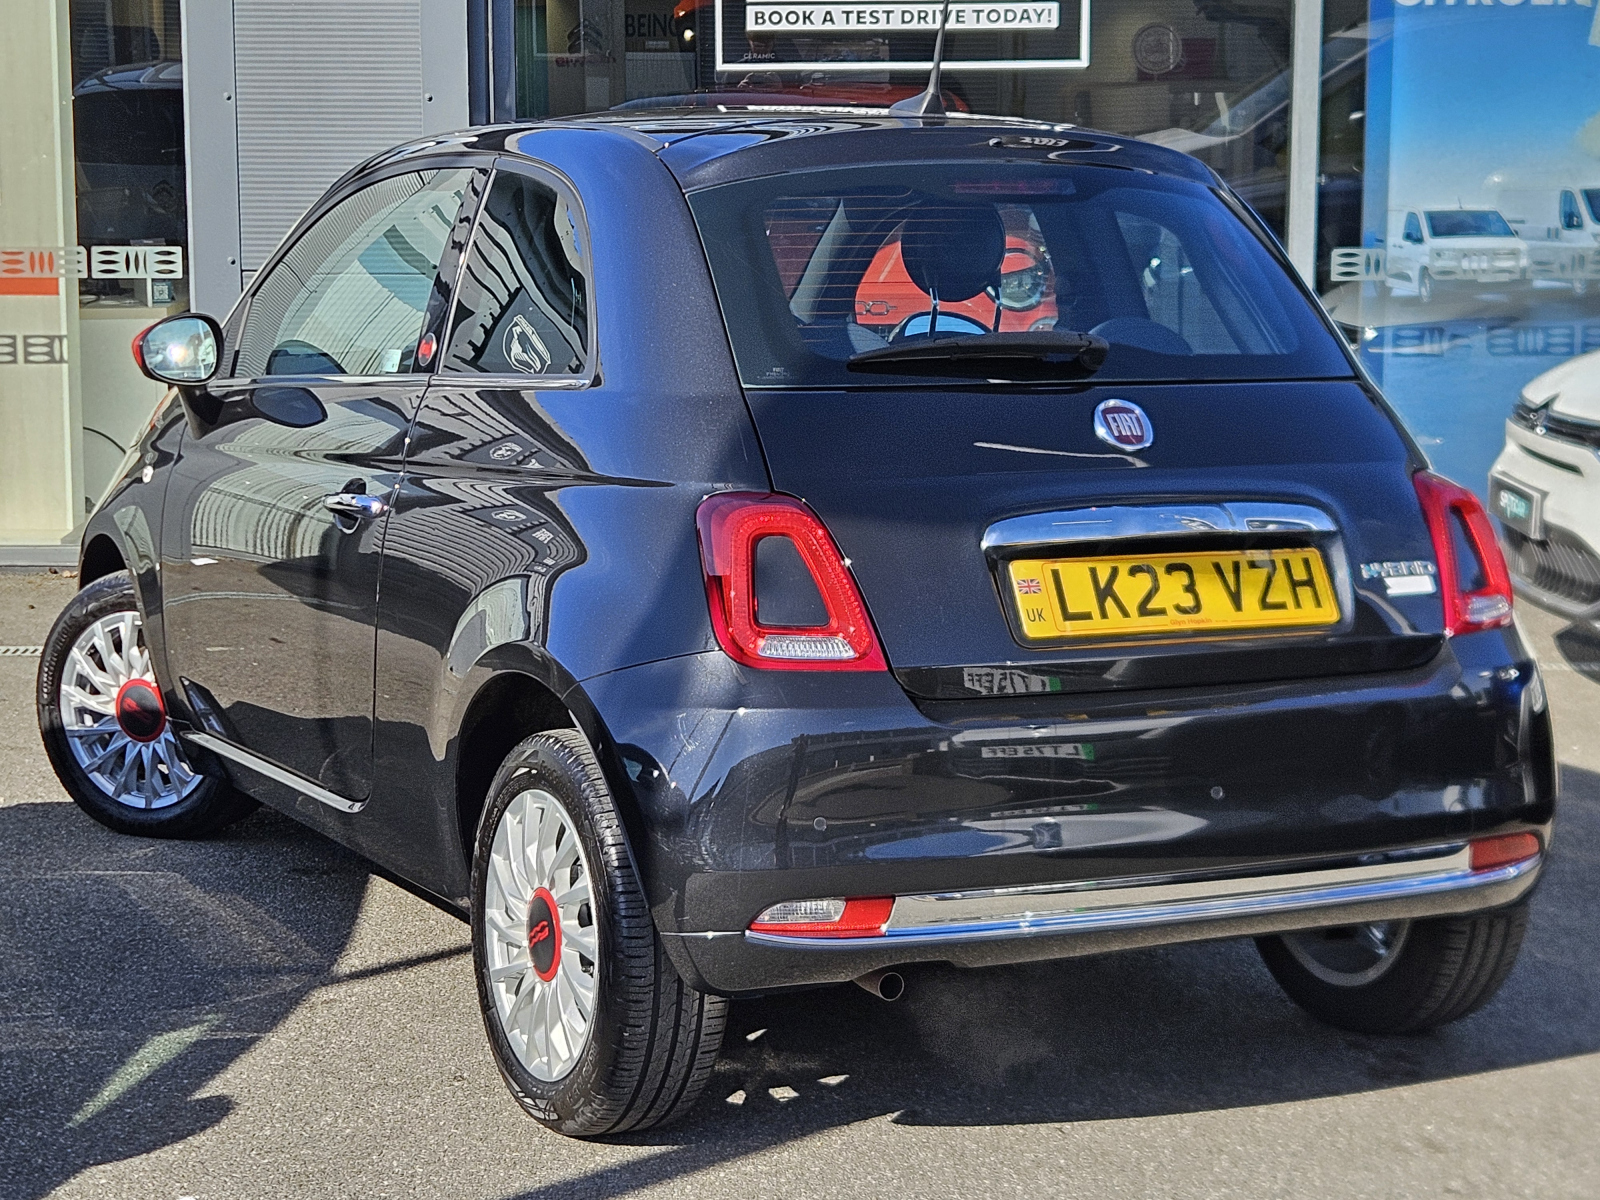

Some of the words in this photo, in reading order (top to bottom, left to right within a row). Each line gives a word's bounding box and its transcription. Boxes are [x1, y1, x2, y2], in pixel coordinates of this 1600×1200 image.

[753, 10, 815, 26] BOOK
[821, 10, 836, 25] A
[842, 10, 895, 25] TEST
[900, 9, 966, 25] DRIVE
[971, 8, 1053, 24] TODAY!
[1105, 413, 1142, 437] FIAT
[1050, 562, 1203, 622] LK23
[1213, 557, 1323, 612] VZH
[1025, 608, 1046, 623] UK
